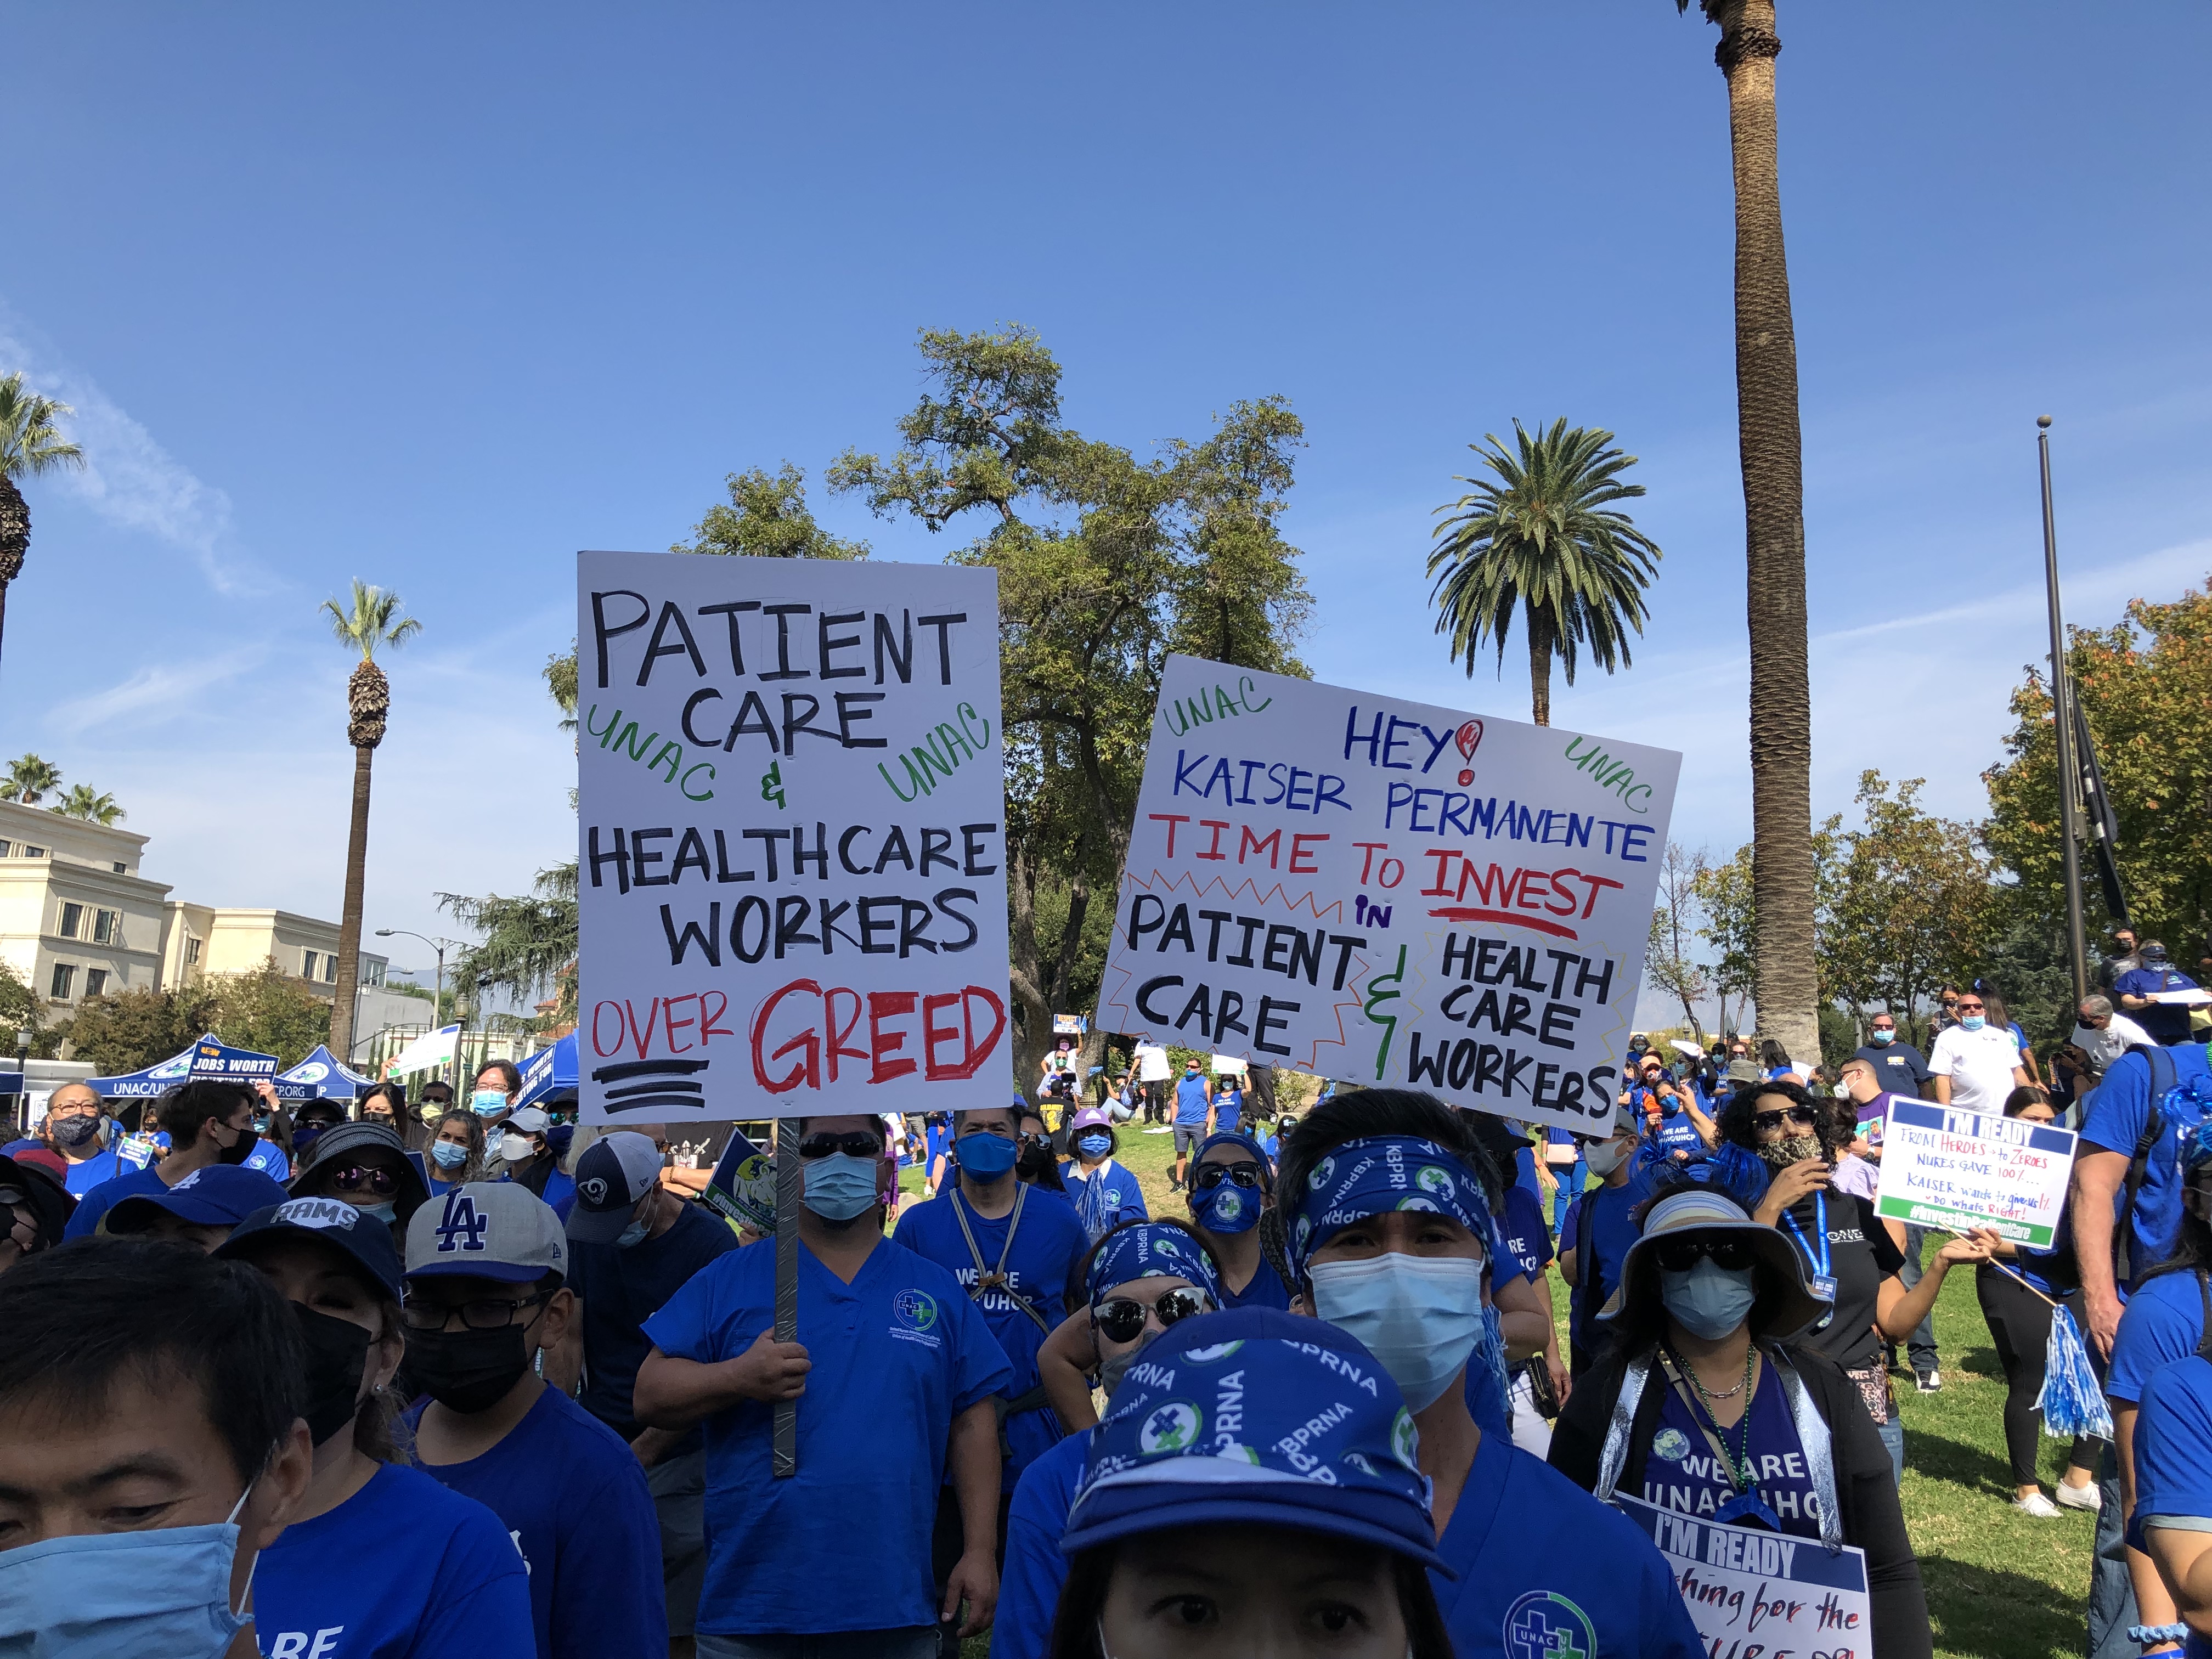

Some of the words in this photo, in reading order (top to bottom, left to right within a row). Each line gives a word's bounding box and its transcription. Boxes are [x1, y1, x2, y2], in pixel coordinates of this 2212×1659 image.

[591, 590, 967, 688] PATIENT
[682, 688, 888, 755] CARE
[1163, 676, 1272, 737] UNAC
[587, 704, 716, 802] UNAC
[878, 702, 989, 803] UNAC
[1345, 706, 1483, 787] HEY!
[761, 759, 785, 810] &
[1565, 736, 1652, 814] UNAC
[1173, 749, 1352, 815] KAISER
[1385, 782, 1656, 862] PERMANENTE
[589, 821, 997, 895] HEALTHCARE
[1149, 814, 1330, 873] TIME
[1352, 843, 1405, 889] TO
[1420, 849, 1624, 919] INVEST
[659, 888, 979, 967] WORKERS
[1128, 894, 1367, 991] PATIENT
[1441, 932, 1614, 1005] HEALTH
[592, 990, 734, 1060] OVER
[749, 978, 1007, 1094] GREED
[1135, 975, 1301, 1057] CARE
[1364, 944, 1407, 1081] &
[1440, 985, 1581, 1051] CARE
[193, 1058, 226, 1071] JOBS
[228, 1059, 275, 1073] WORTH
[510, 1075, 538, 1109] IGHTING
[539, 1062, 552, 1082] FOR
[527, 1047, 554, 1078] WORTH
[1408, 1031, 1617, 1119] WORKERS
[1658, 1133, 1696, 1143] C/UHCP
[1674, 1126, 1689, 1135] ARE
[1901, 1128, 1936, 1148] FROM
[1940, 1133, 1987, 1156] HEROES
[1997, 1148, 2008, 1161] to
[2010, 1149, 2048, 1169] ZEROES
[1942, 1109, 1975, 1136] I'M
[1978, 1116, 2034, 1148] READY
[1328, 1156, 1375, 1208] KBPRNA
[1385, 1144, 1408, 1190] KBPR
[1906, 1172, 1956, 1193] KAISER
[1959, 1160, 1993, 1175] GAVE
[270, 1200, 360, 1231] RAMS
[435, 1186, 489, 1254] LA
[712, 1192, 776, 1238] #InvestinPa
[1988, 1204, 2027, 1221] RIGHT!
[1104, 1237, 1131, 1274] KBPRNA
[1137, 1228, 1149, 1265] KBPRNA
[1507, 1237, 1527, 1255] RE
[955, 1267, 979, 1286] WE
[1215, 1369, 1245, 1449] PRNA
[1271, 1402, 1354, 1455] BPRNA
[1682, 1454, 1729, 1485] WE
[1739, 1452, 1806, 1482] ARE
[1654, 1513, 1699, 1560] I'M
[1707, 1528, 1796, 1579] READY
[1675, 1567, 1746, 1627] hing
[1815, 1591, 1860, 1633] the
[256, 1624, 345, 1659] RE
[1520, 1629, 1554, 1646] UNAC
